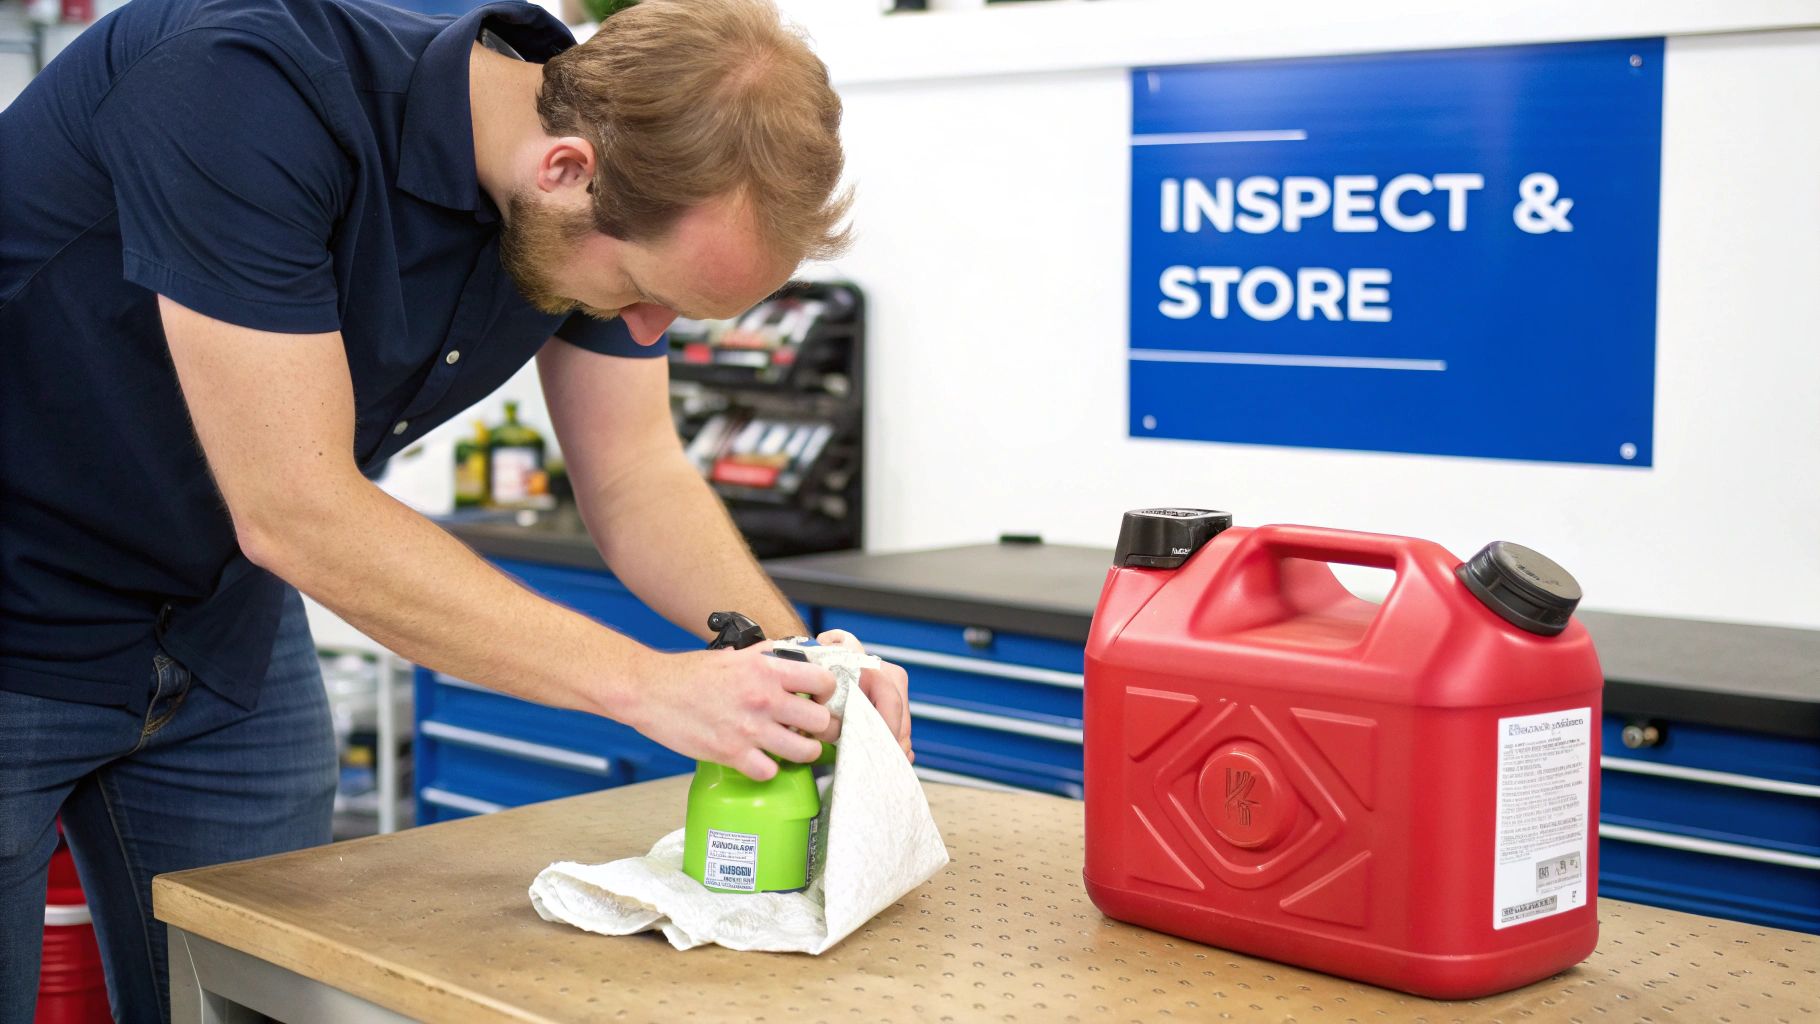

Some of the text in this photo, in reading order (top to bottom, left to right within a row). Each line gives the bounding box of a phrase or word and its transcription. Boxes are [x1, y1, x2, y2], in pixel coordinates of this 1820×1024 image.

[1160, 172, 1574, 234] INSPECT &
[1158, 265, 1392, 323] STORE
